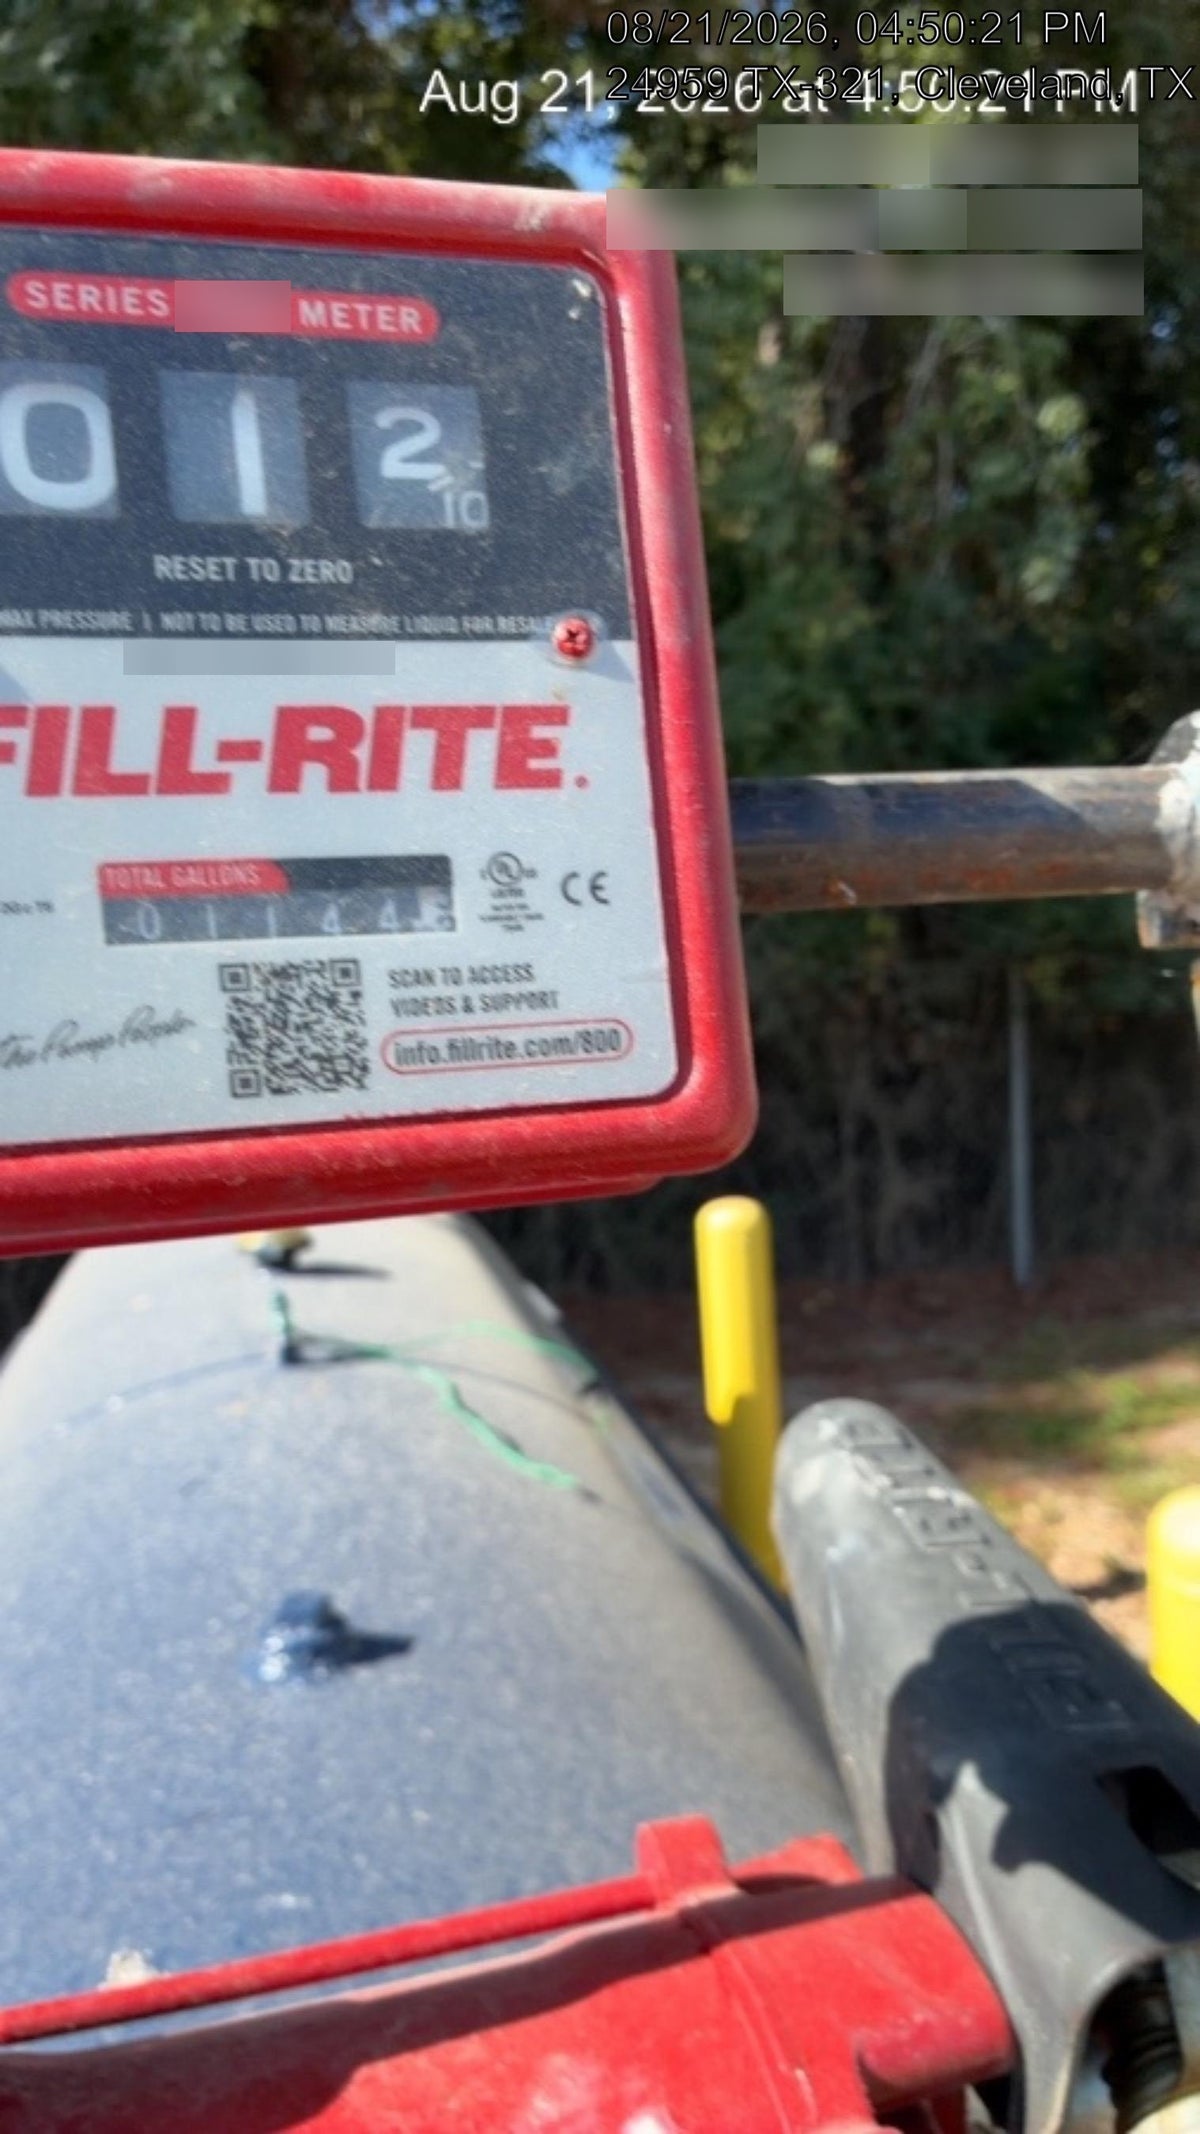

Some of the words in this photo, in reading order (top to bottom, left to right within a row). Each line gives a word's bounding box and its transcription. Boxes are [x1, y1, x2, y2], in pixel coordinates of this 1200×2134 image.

[24, 279, 170, 317] SERIES
[299, 299, 423, 334] METER
[153, 554, 237, 583] RESET
[245, 556, 280, 583] TO
[288, 558, 354, 585] ZERO
[38, 609, 134, 632] PRESSURE
[160, 611, 194, 632] NOT
[199, 612, 221, 632] TO
[224, 612, 249, 633] BE
[251, 612, 297, 634] USED
[299, 613, 321, 634] TO
[324, 613, 400, 635] MEASURE
[402, 615, 459, 635] LIQUID
[462, 615, 494, 635] FOR
[496, 615, 557, 636] RESAL
[105, 865, 162, 889] TOTAL
[170, 862, 262, 887] GALLONS
[560, 870, 610, 906] CE
[388, 967, 436, 989] SCAN
[440, 966, 463, 987] TO
[467, 962, 535, 986] ACCESS
[390, 996, 456, 1017] VIDEOS
[461, 995, 474, 1014] &
[478, 990, 559, 1013] SUPPORT
[393, 1027, 622, 1067] info.fillrite.com/800
